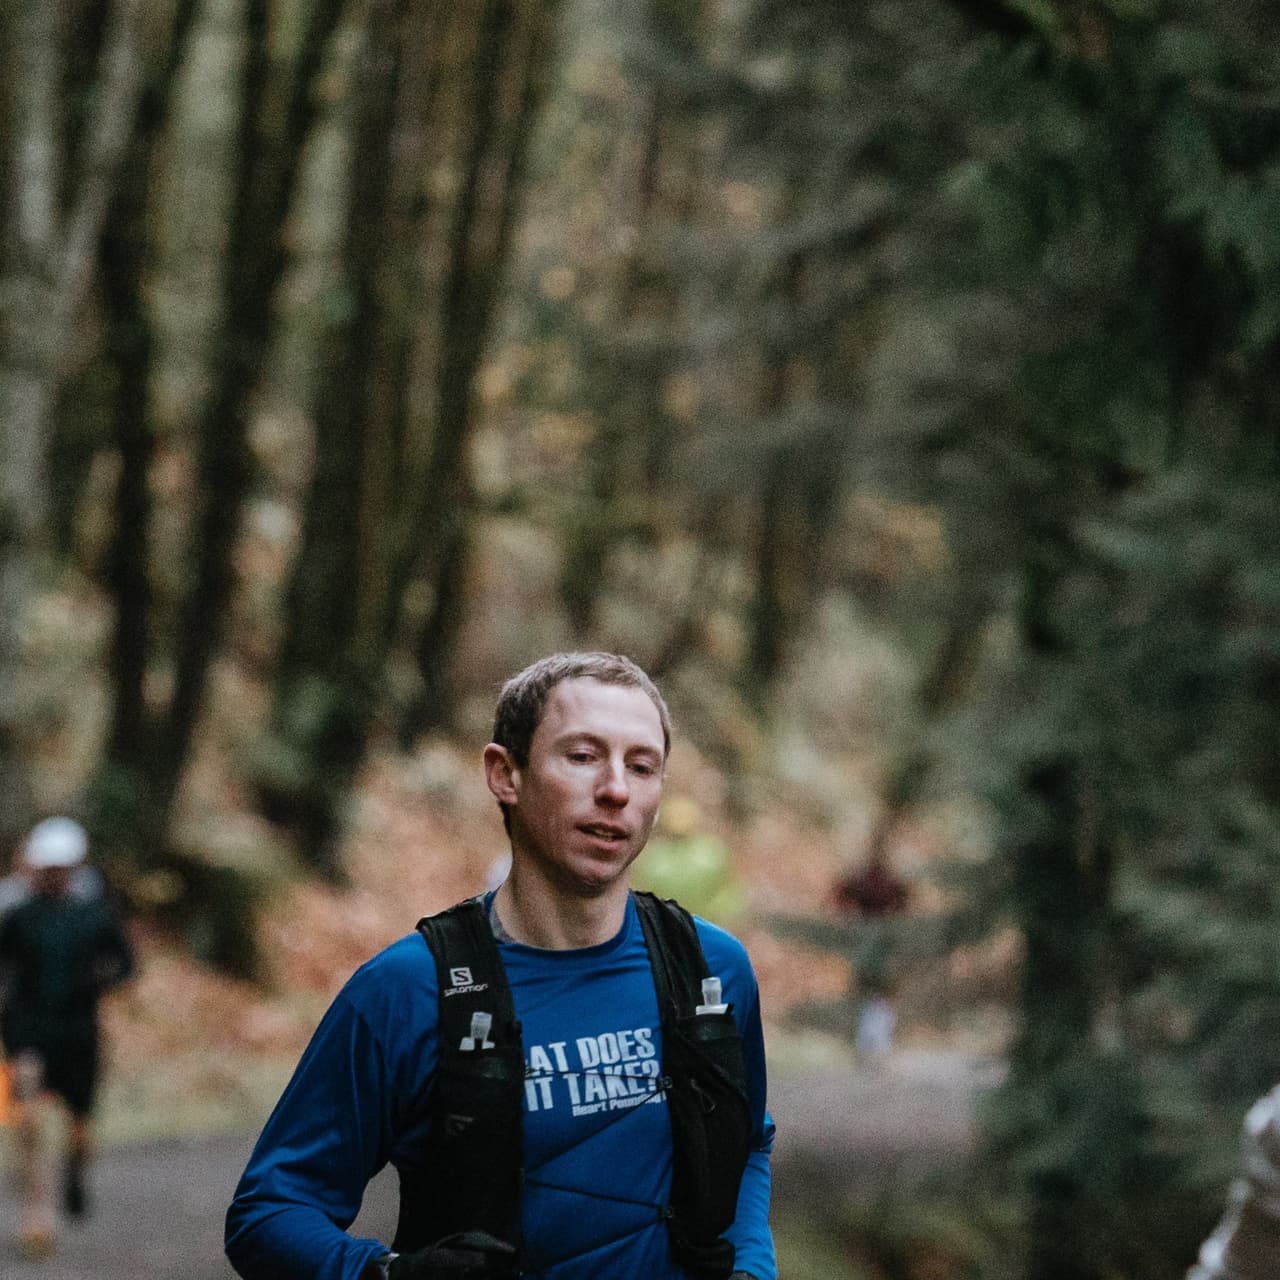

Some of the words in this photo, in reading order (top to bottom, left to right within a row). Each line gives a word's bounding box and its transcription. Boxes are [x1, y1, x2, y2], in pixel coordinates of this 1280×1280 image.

[524, 1040, 569, 1077] AT
[576, 1027, 656, 1069] DOES
[524, 1076, 554, 1112] IT
[563, 1059, 659, 1105] TAKE?
